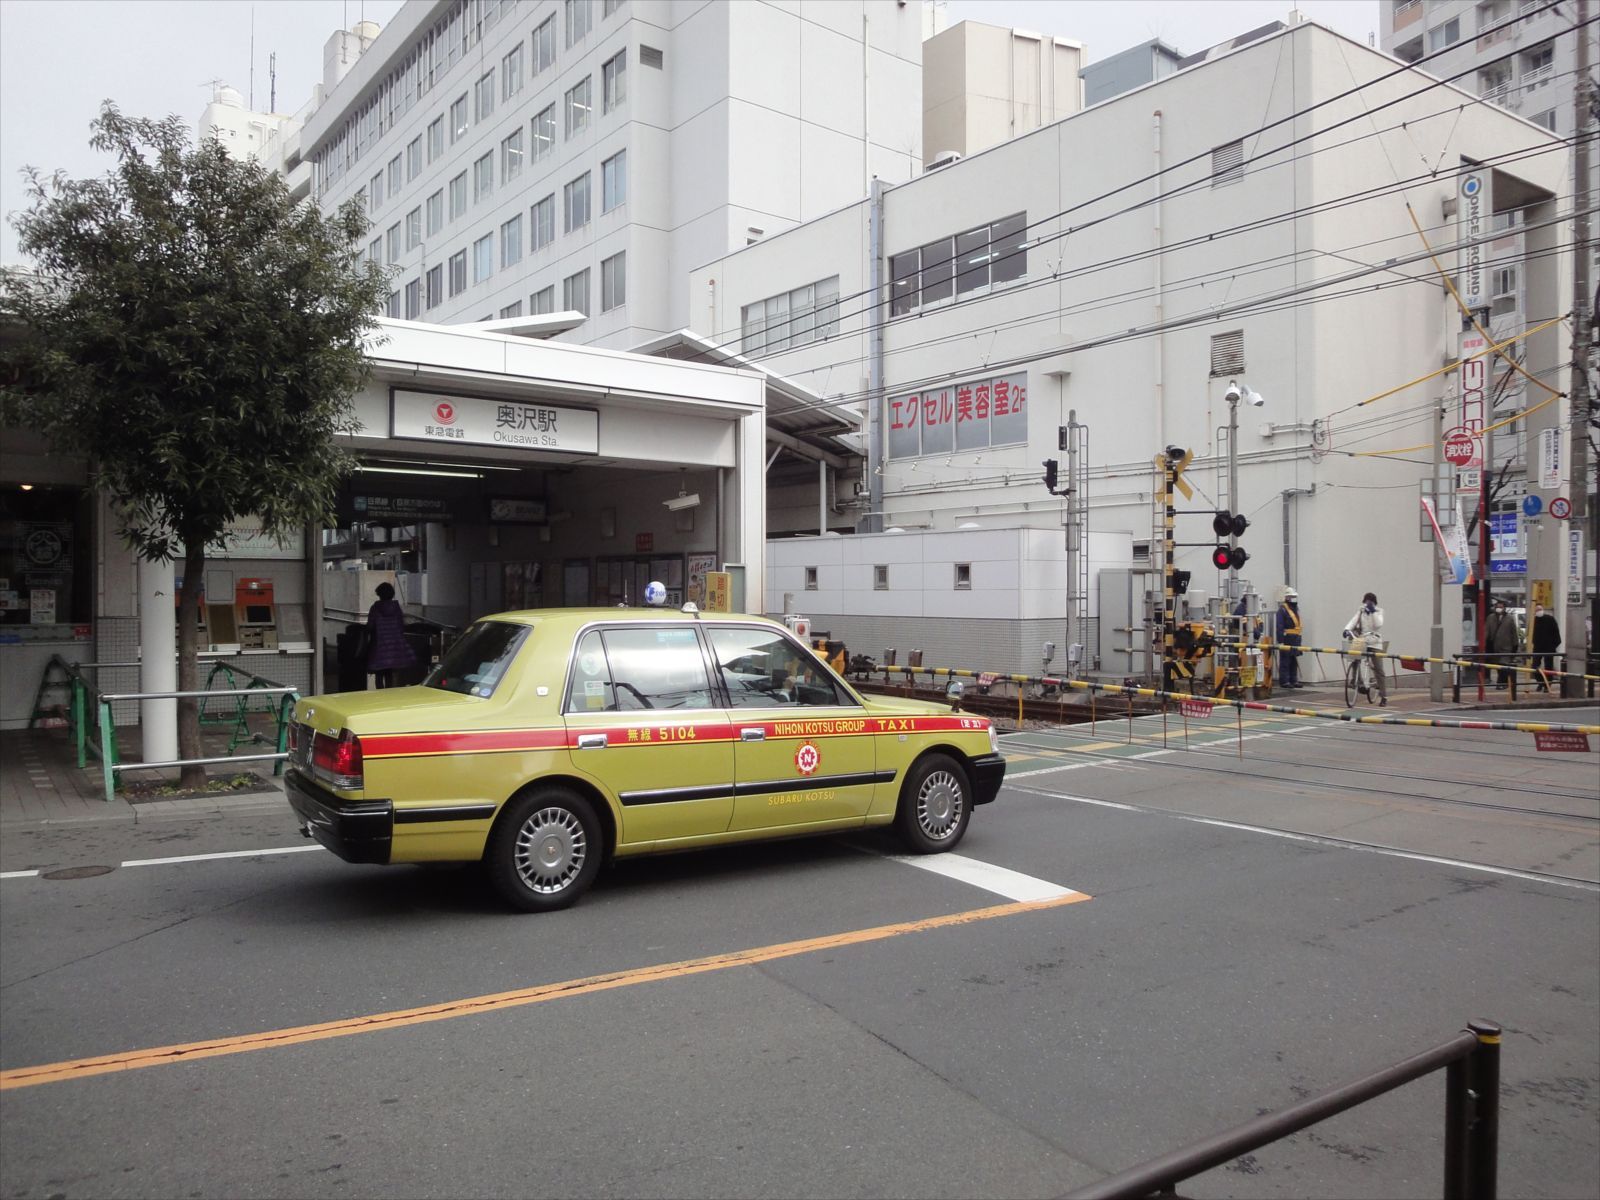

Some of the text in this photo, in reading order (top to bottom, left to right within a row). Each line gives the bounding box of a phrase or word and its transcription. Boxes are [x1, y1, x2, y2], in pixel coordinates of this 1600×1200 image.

[1470, 195, 1480, 234] ONCE
[496, 404, 557, 433] 奥沢駅
[424, 425, 464, 438] 東急電鉄
[493, 431, 559, 447] Okusawa Sta.
[1446, 443, 1472, 458] 消火栓
[774, 720, 866, 735] NIHON KOTSU GROUP
[877, 719, 915, 731] TAXI
[627, 726, 696, 742] 無線 5104
[804, 753, 811, 763] N
[768, 791, 835, 806] SUBARU KOTSU
